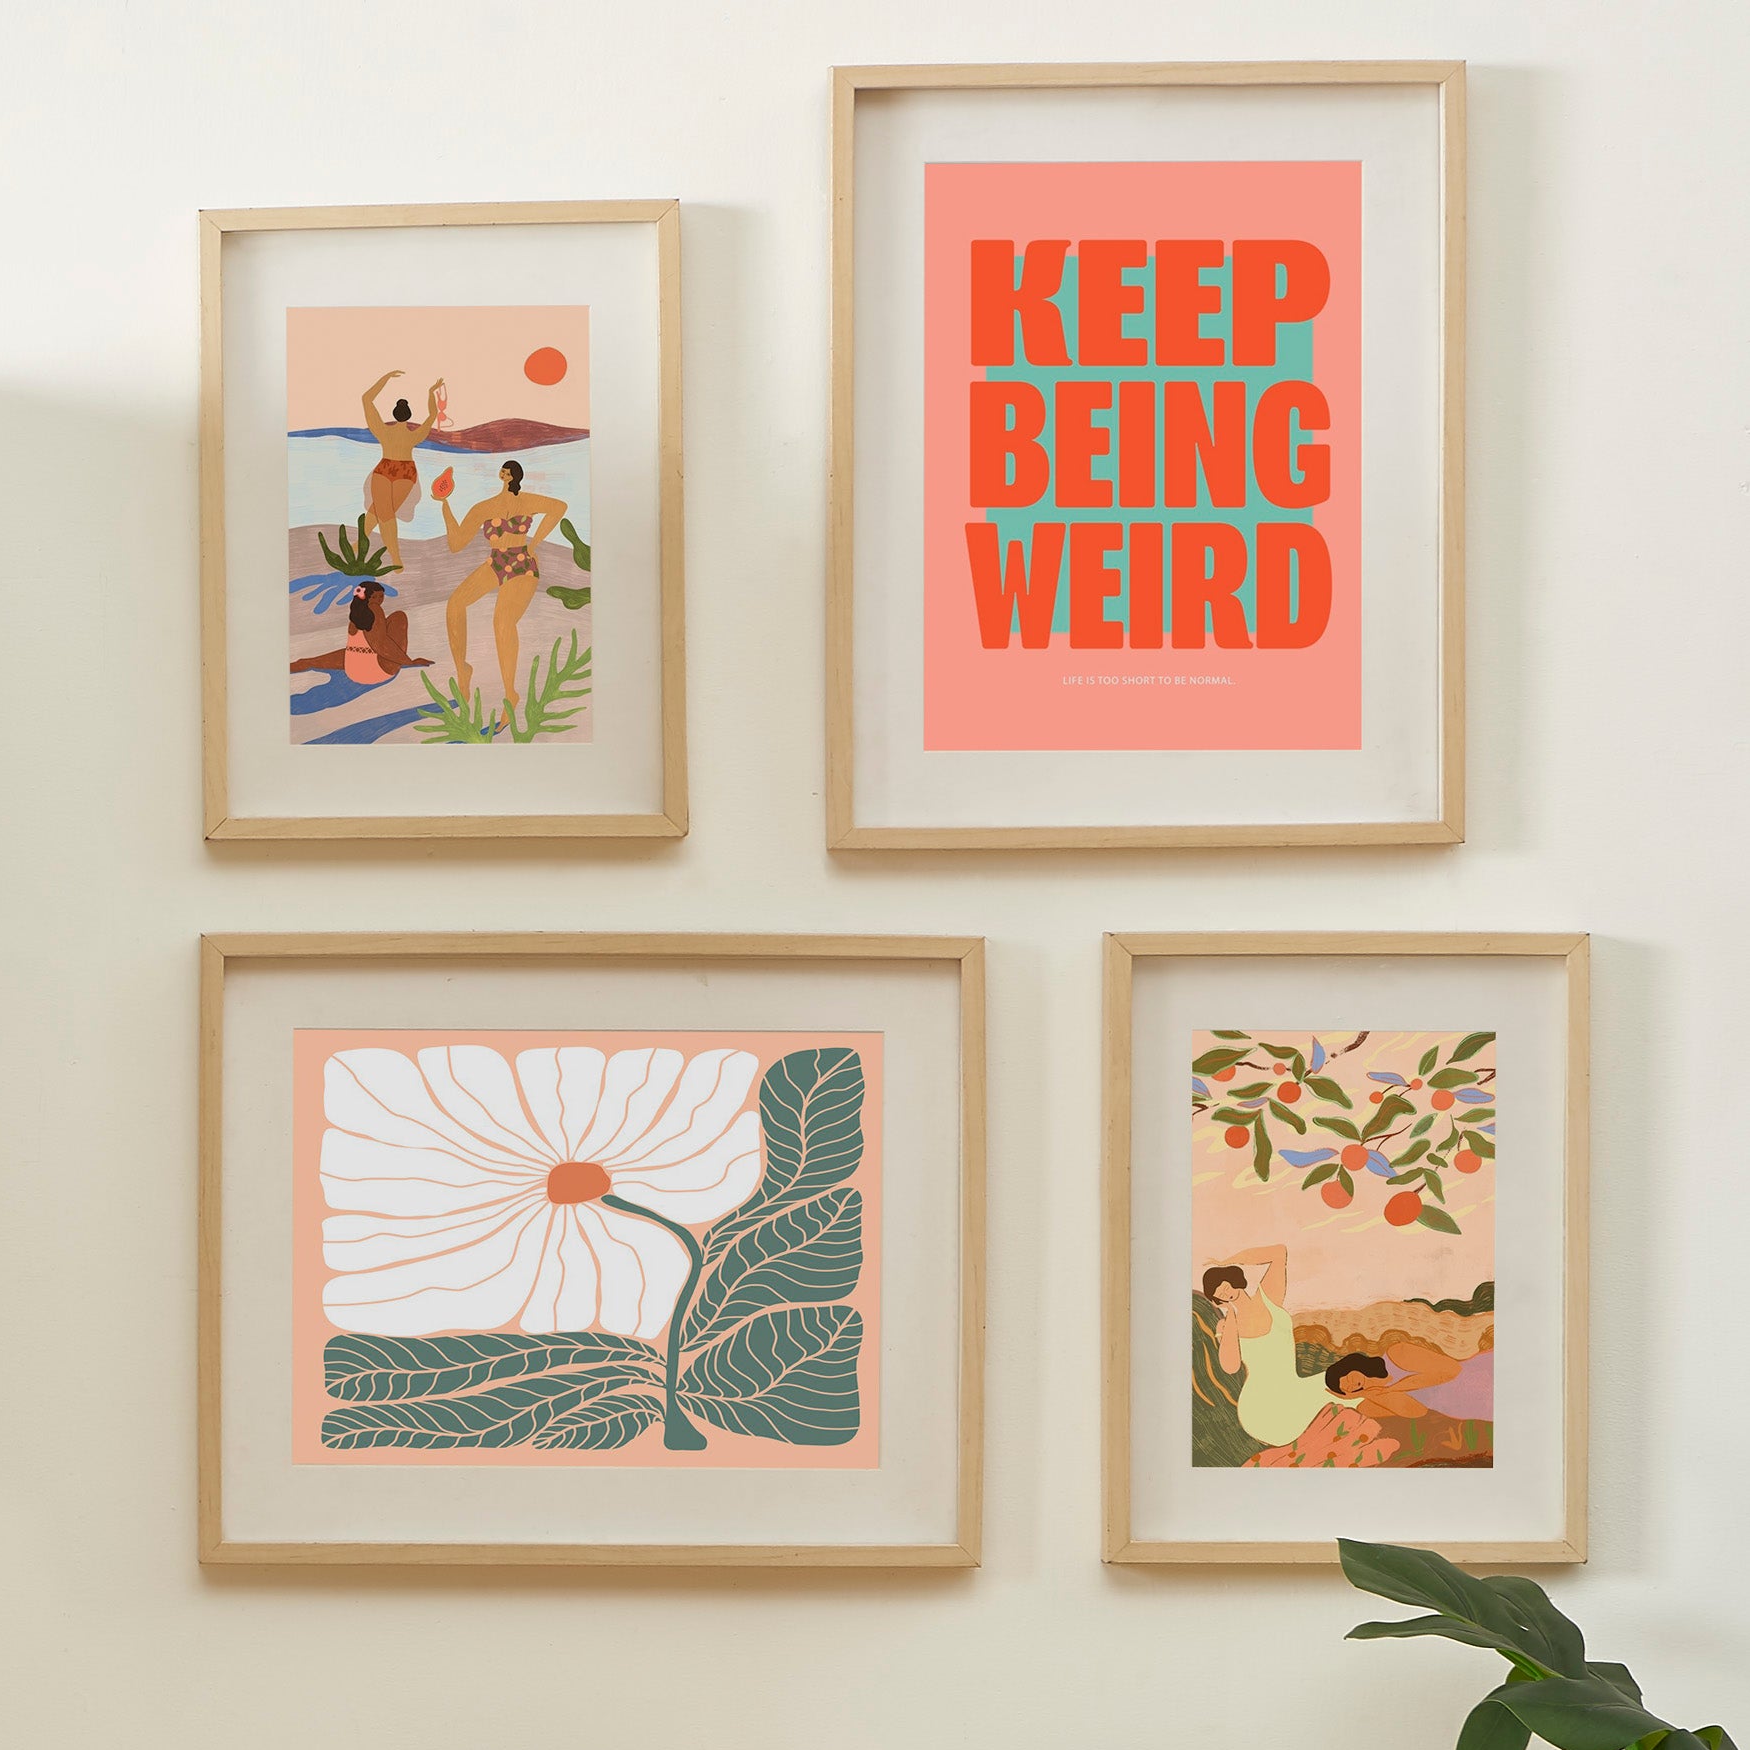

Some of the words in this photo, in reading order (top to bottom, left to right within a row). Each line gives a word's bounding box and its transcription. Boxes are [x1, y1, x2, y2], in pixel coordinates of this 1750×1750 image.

[970, 239, 1331, 367] KEEP
[969, 380, 1331, 509] BEING
[964, 522, 1333, 650] WEIRD
[1062, 675, 1083, 685] LIFE
[1086, 675, 1095, 685] IS
[1097, 675, 1120, 685] TOO
[1122, 675, 1155, 685] SHORT
[1158, 675, 1172, 685] TO
[1174, 675, 1187, 685] BE
[1189, 675, 1236, 685] NORMAL.
